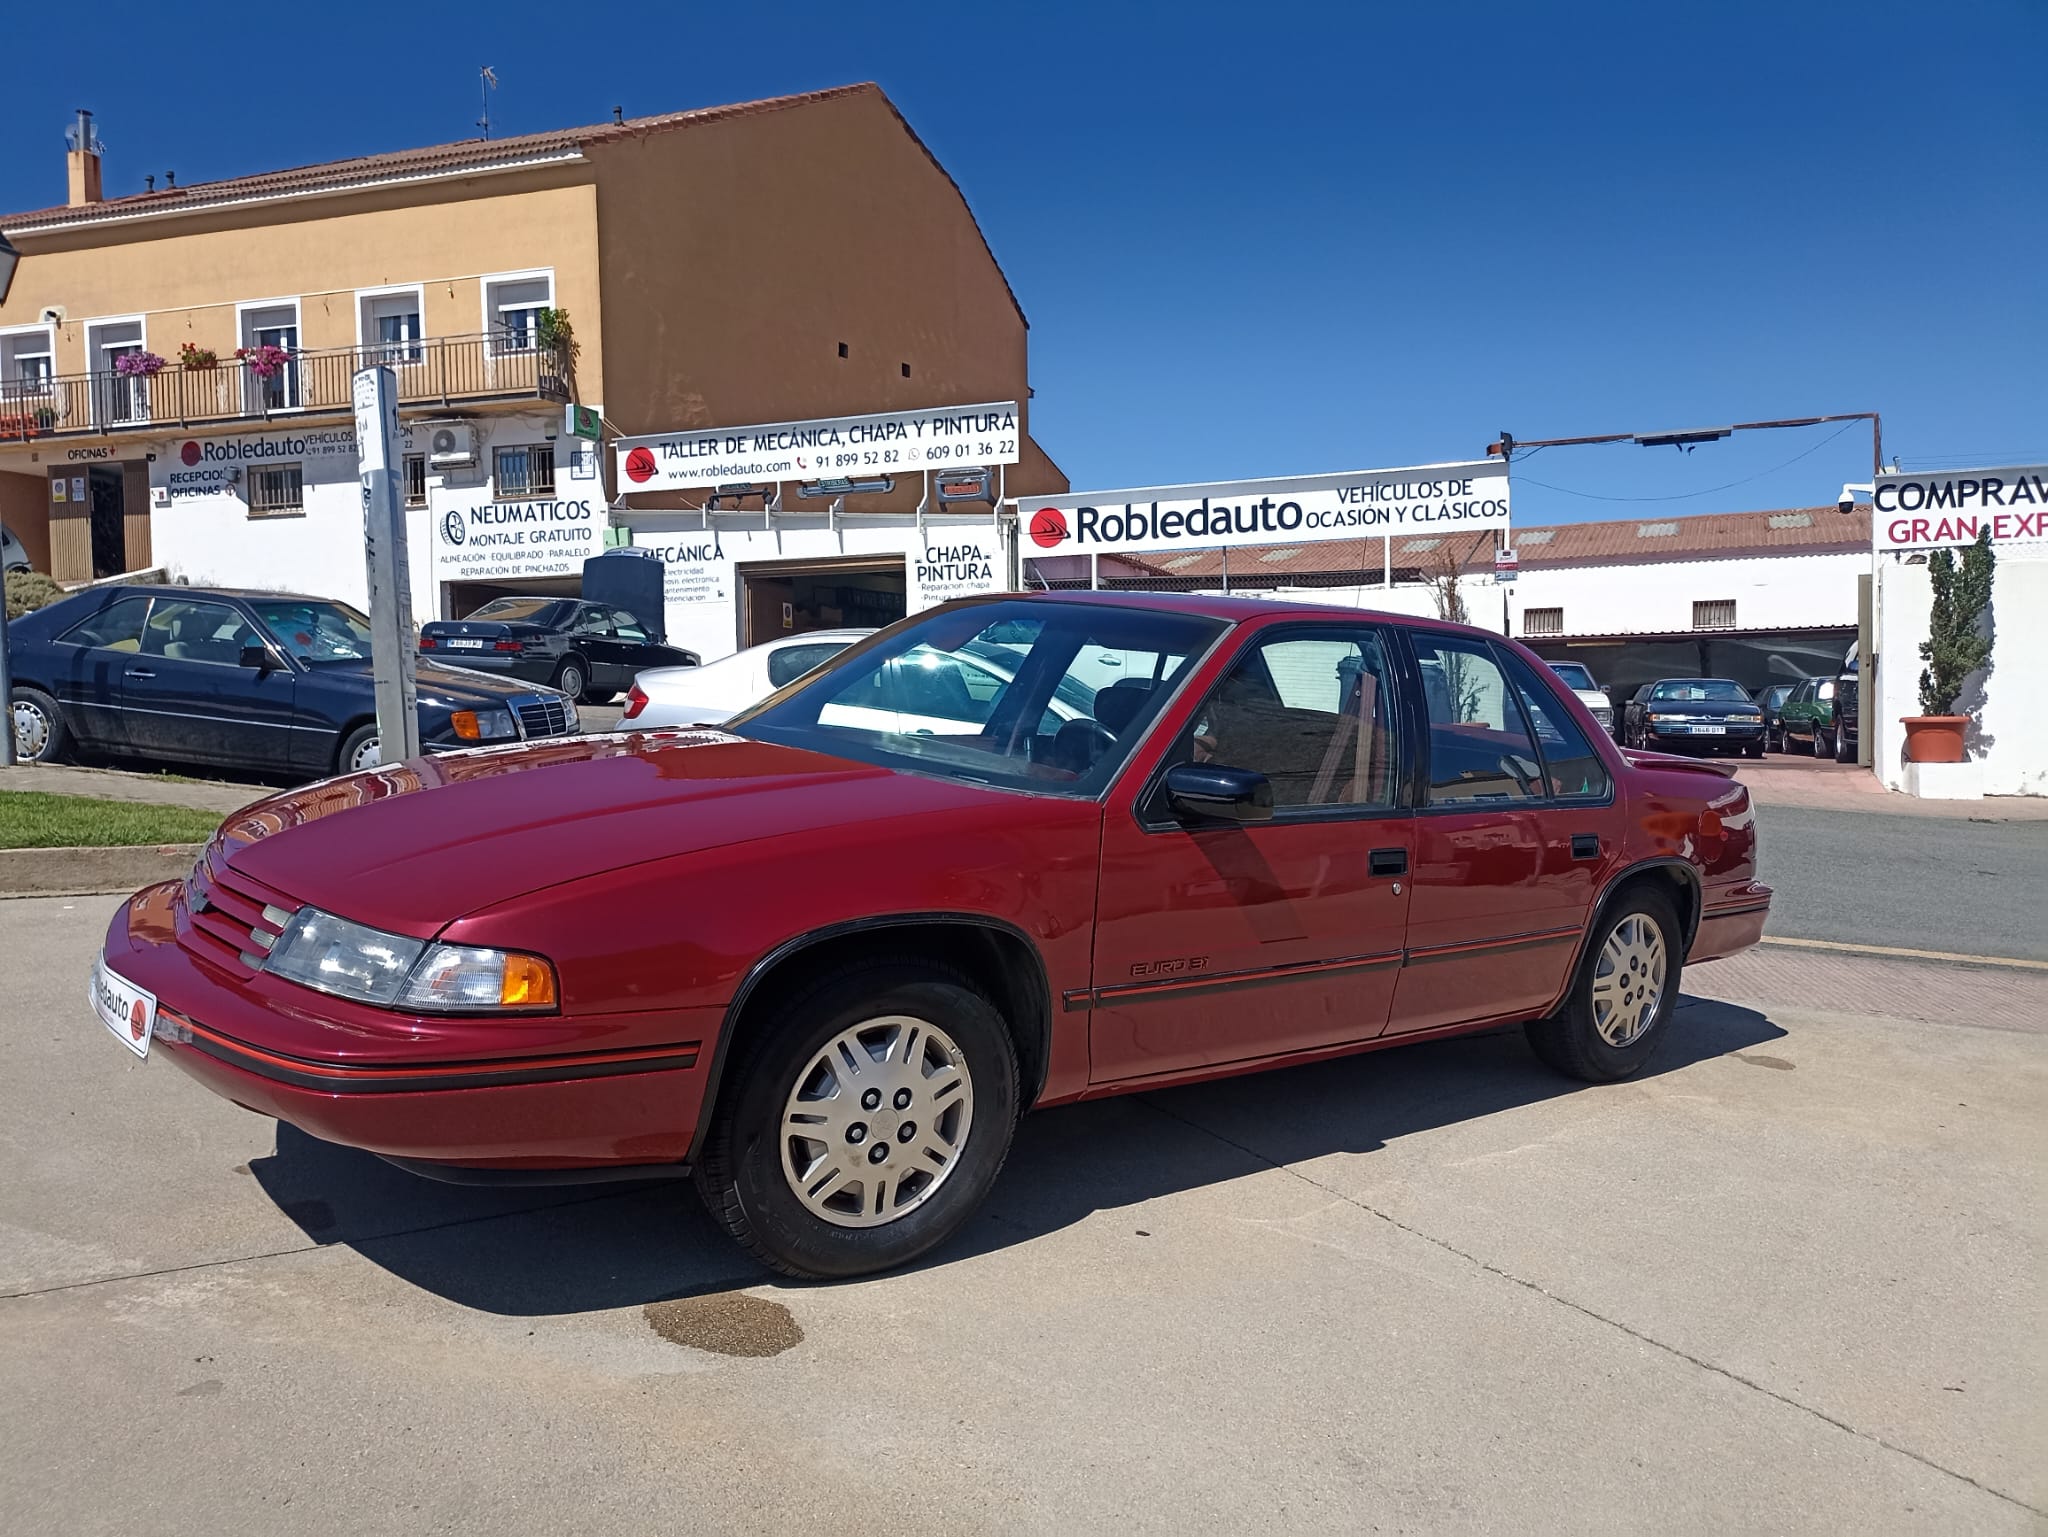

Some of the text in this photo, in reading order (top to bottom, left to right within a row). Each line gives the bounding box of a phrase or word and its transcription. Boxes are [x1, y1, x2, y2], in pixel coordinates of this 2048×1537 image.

[303, 431, 353, 446] VEHÍCULOS
[659, 411, 1016, 459] TALLER DE MECÁNICA, CHAPA Y PINTURA
[67, 447, 108, 460] OFICINAS
[204, 436, 306, 461] Robledauto
[668, 440, 1015, 479] www.robledauto.com 91 899 52 82 609 01 36 22
[171, 484, 221, 498] OFICINAS
[1337, 479, 1473, 504] VEHÍCULOS DE
[470, 500, 591, 525] NEUMATICOS
[1077, 497, 1303, 544] Robledauto
[1306, 499, 1508, 529] OCASIÓN Y CLÁSICOS
[469, 528, 592, 547] MONTAJE GRATUITO
[1888, 515, 1979, 544] GRAN
[549, 547, 591, 558] PARALELO
[926, 544, 983, 564] CHAPA
[512, 564, 522, 575] DE
[525, 563, 570, 574] PINCHAZOS
[917, 562, 993, 582] PINTURA
[664, 585, 711, 595] antenimiento
